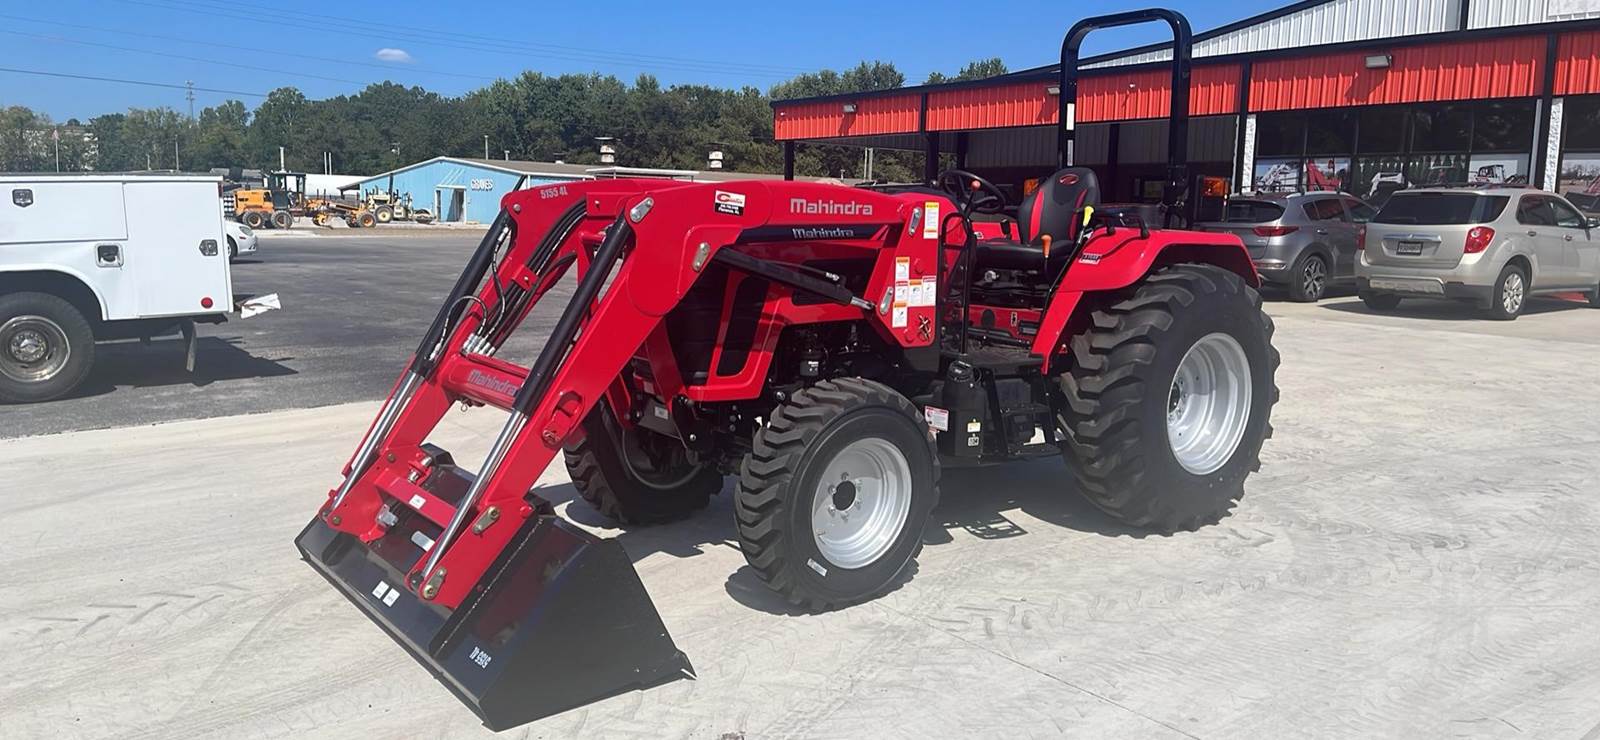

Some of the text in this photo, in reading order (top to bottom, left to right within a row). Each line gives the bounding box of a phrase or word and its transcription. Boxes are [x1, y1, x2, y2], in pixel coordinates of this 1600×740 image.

[540, 187, 559, 200] 5155
[790, 198, 873, 216] Mahindra
[792, 227, 854, 239] Mahindra
[467, 369, 519, 397] Mahindra
